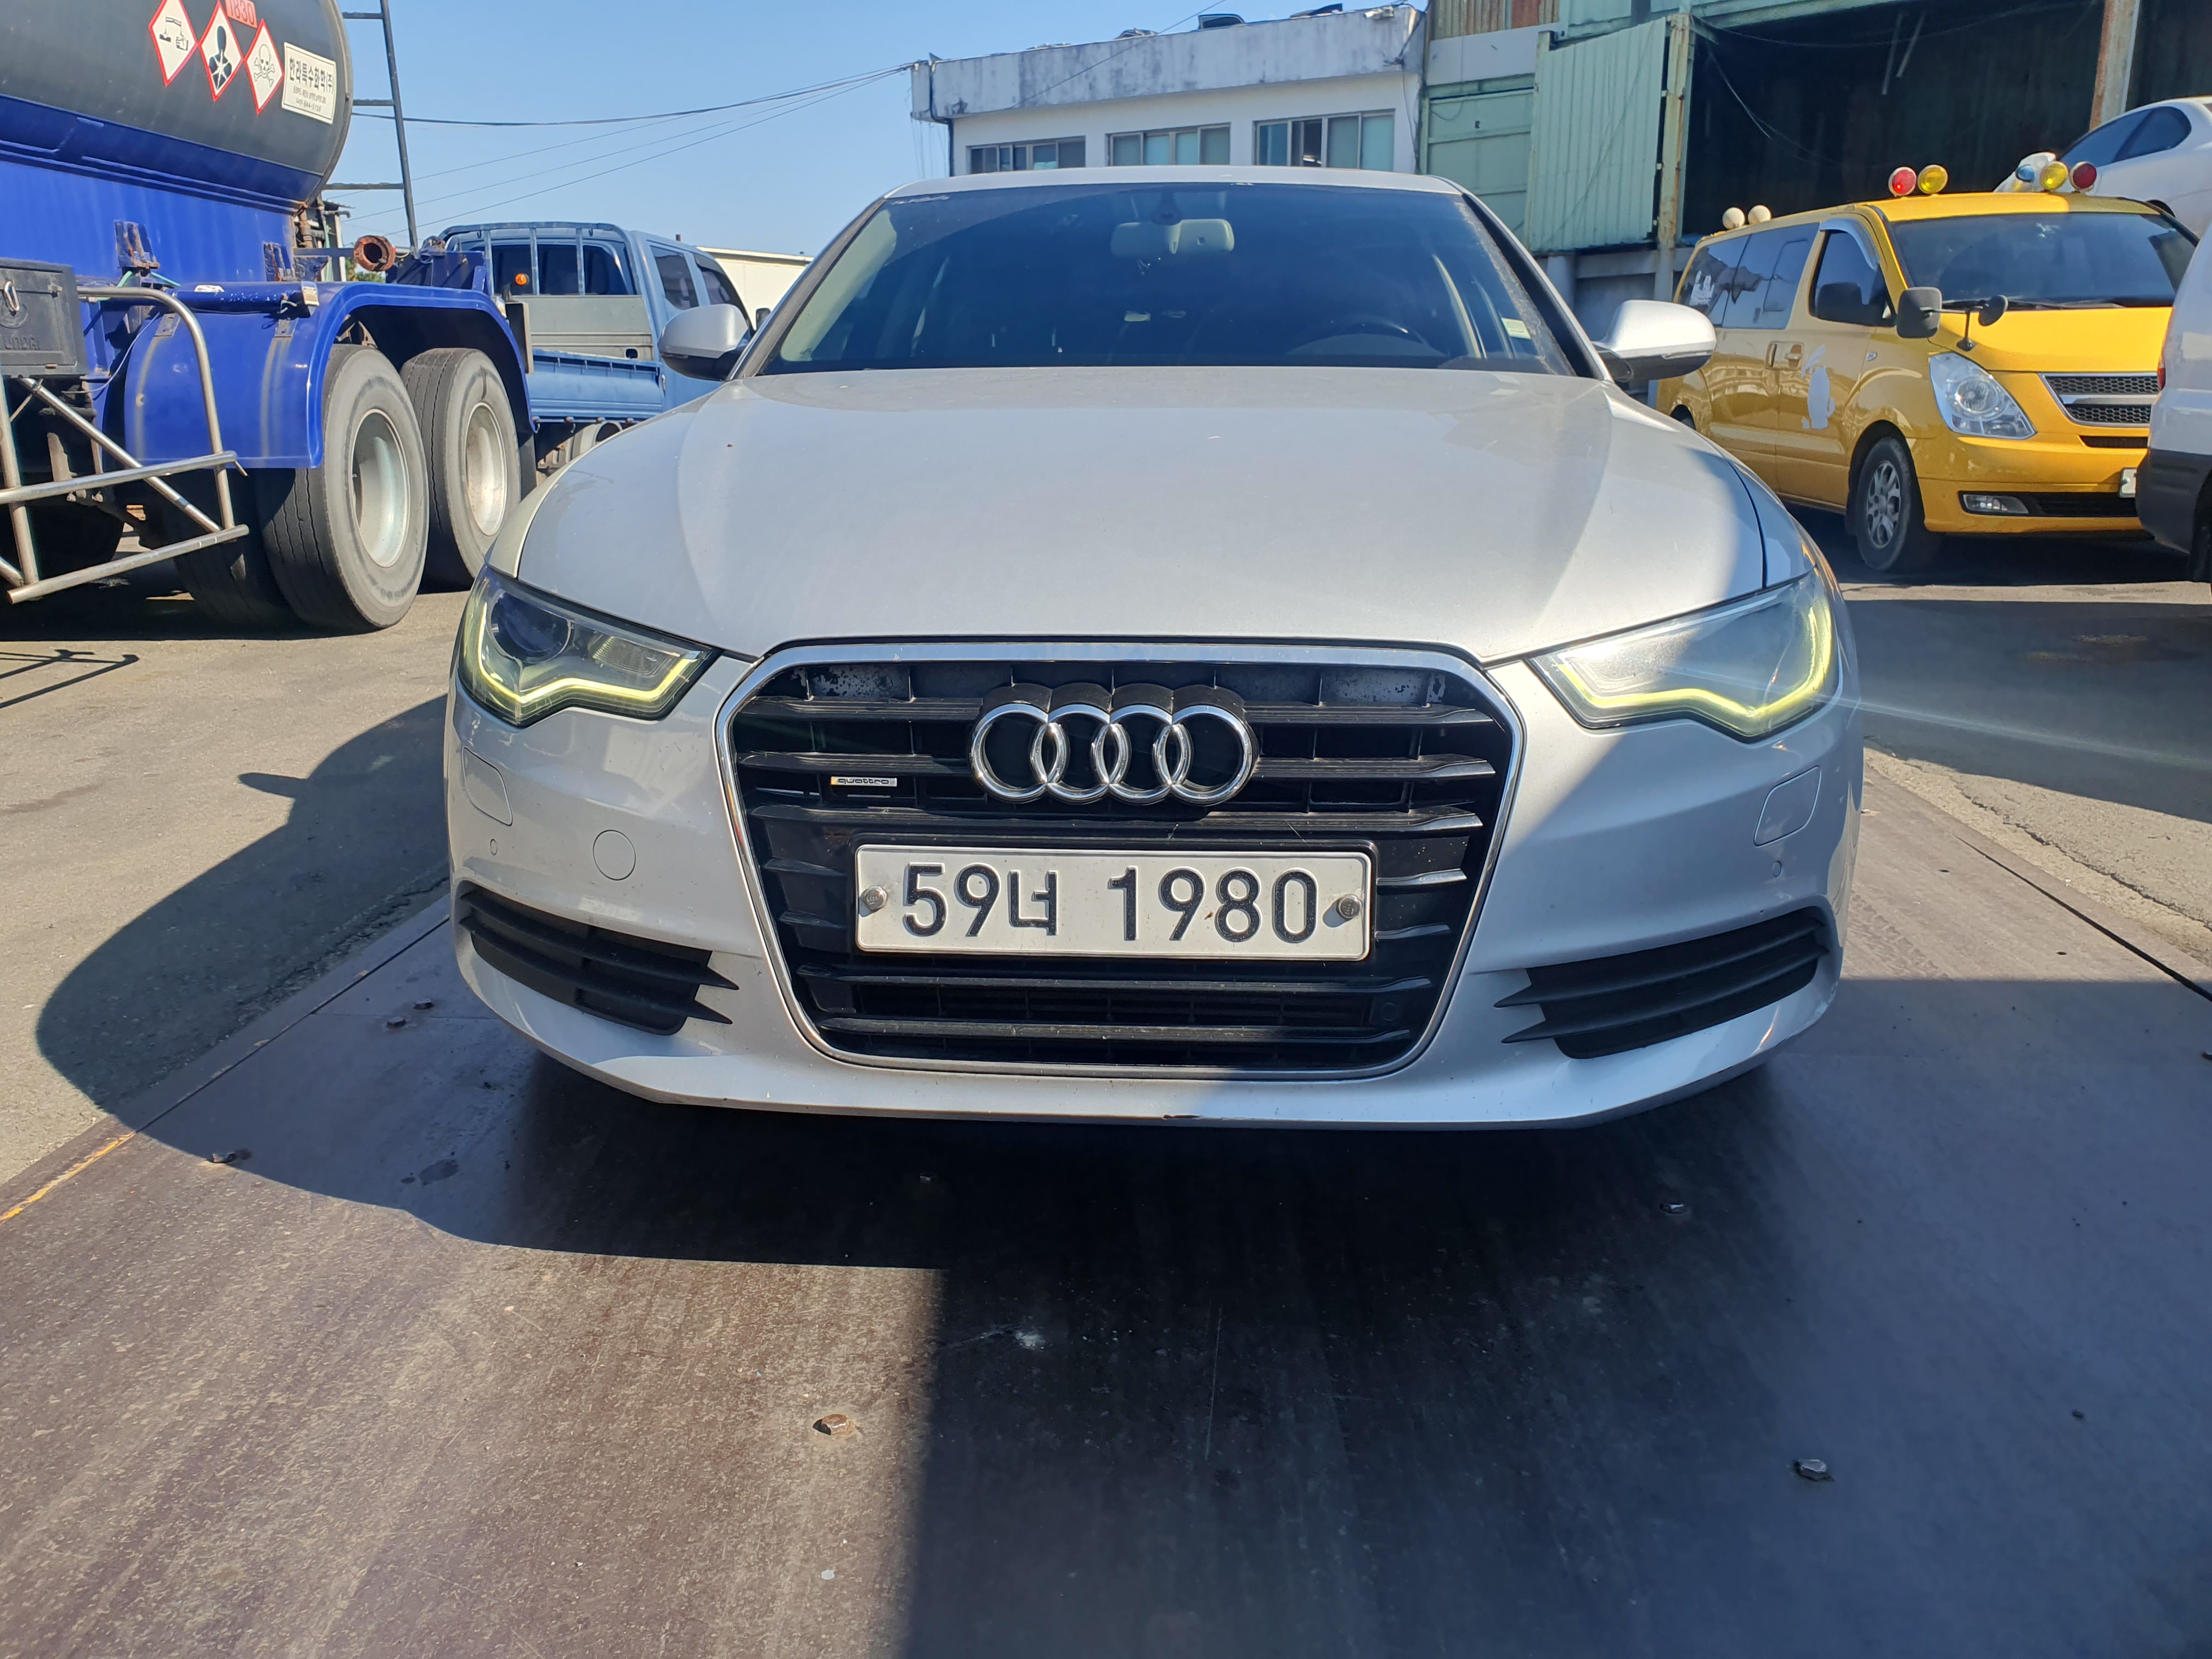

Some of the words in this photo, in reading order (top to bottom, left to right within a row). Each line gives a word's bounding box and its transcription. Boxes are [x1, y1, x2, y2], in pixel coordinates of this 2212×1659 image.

[230, 0, 254, 25] 1830
[903, 862, 1058, 937] 59너
[1108, 866, 1318, 943] 1980
